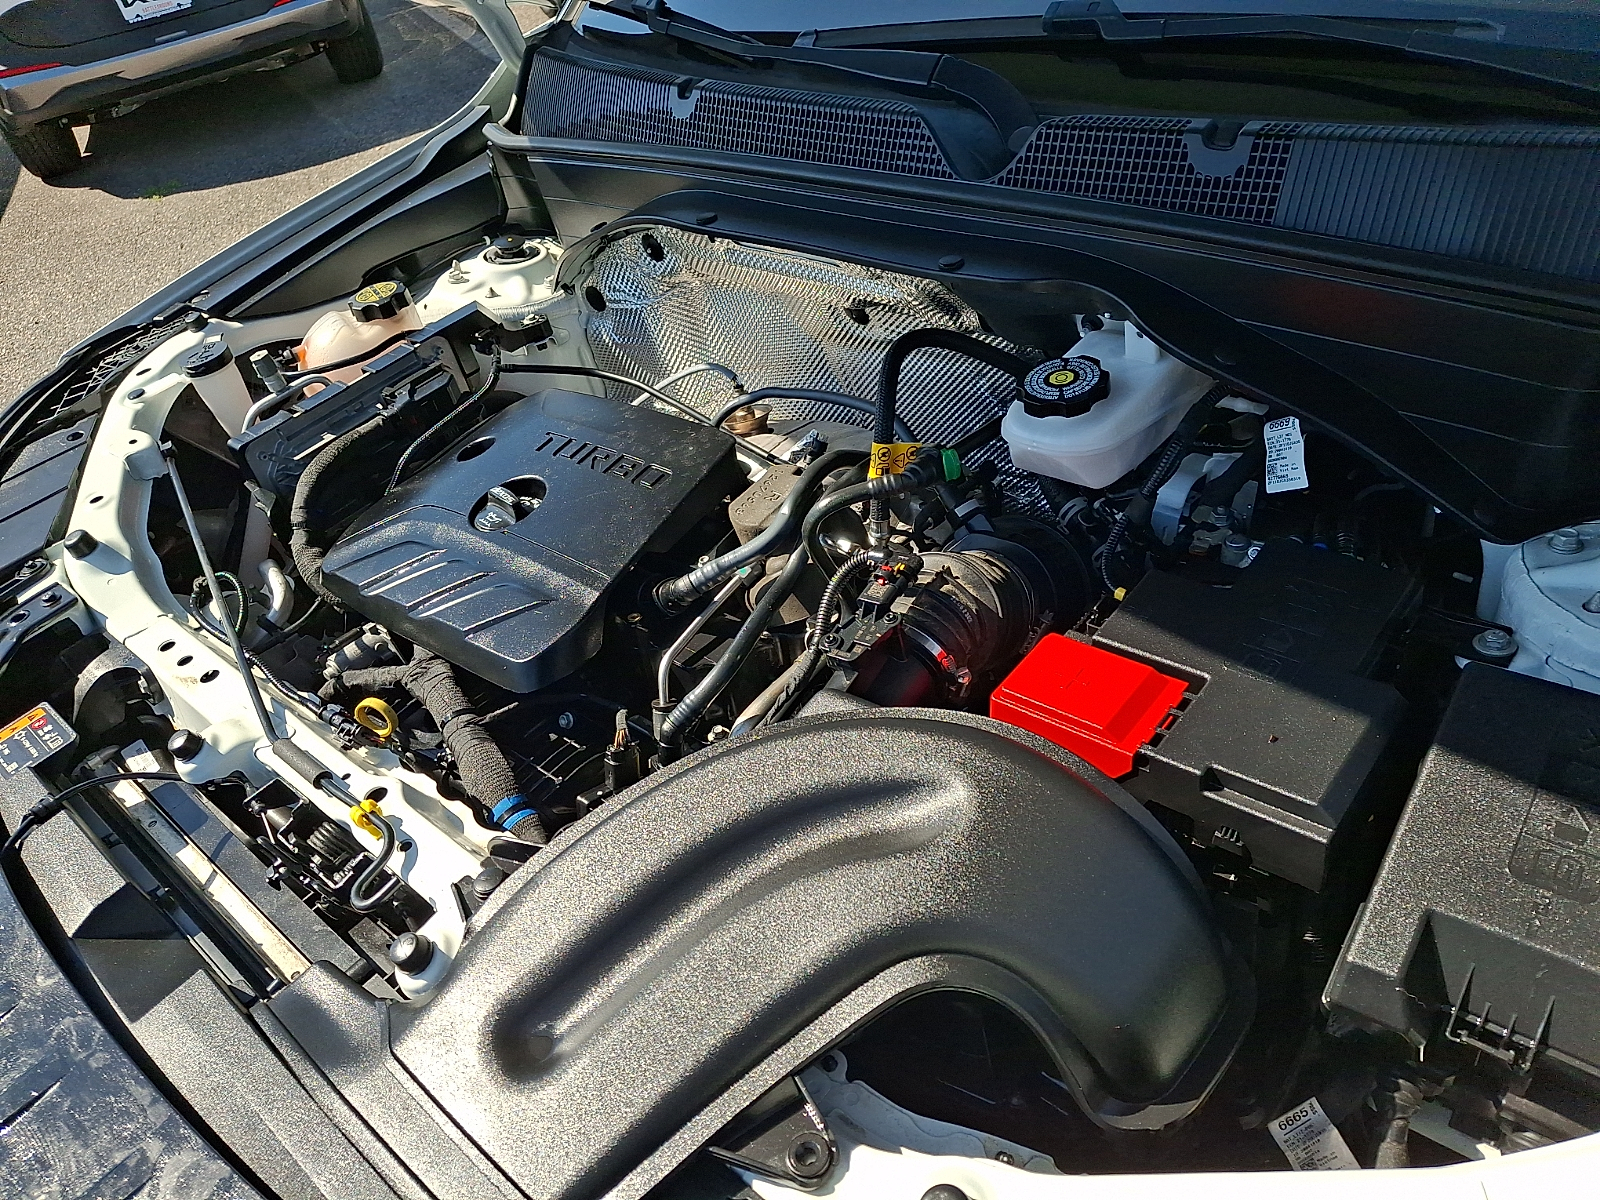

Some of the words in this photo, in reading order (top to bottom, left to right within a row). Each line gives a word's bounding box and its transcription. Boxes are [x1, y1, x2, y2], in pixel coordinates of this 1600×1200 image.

[1269, 418, 1291, 430] 6669
[535, 431, 673, 489] TURBO
[764, 490, 783, 503] R
[1278, 1107, 1309, 1131] 6665
